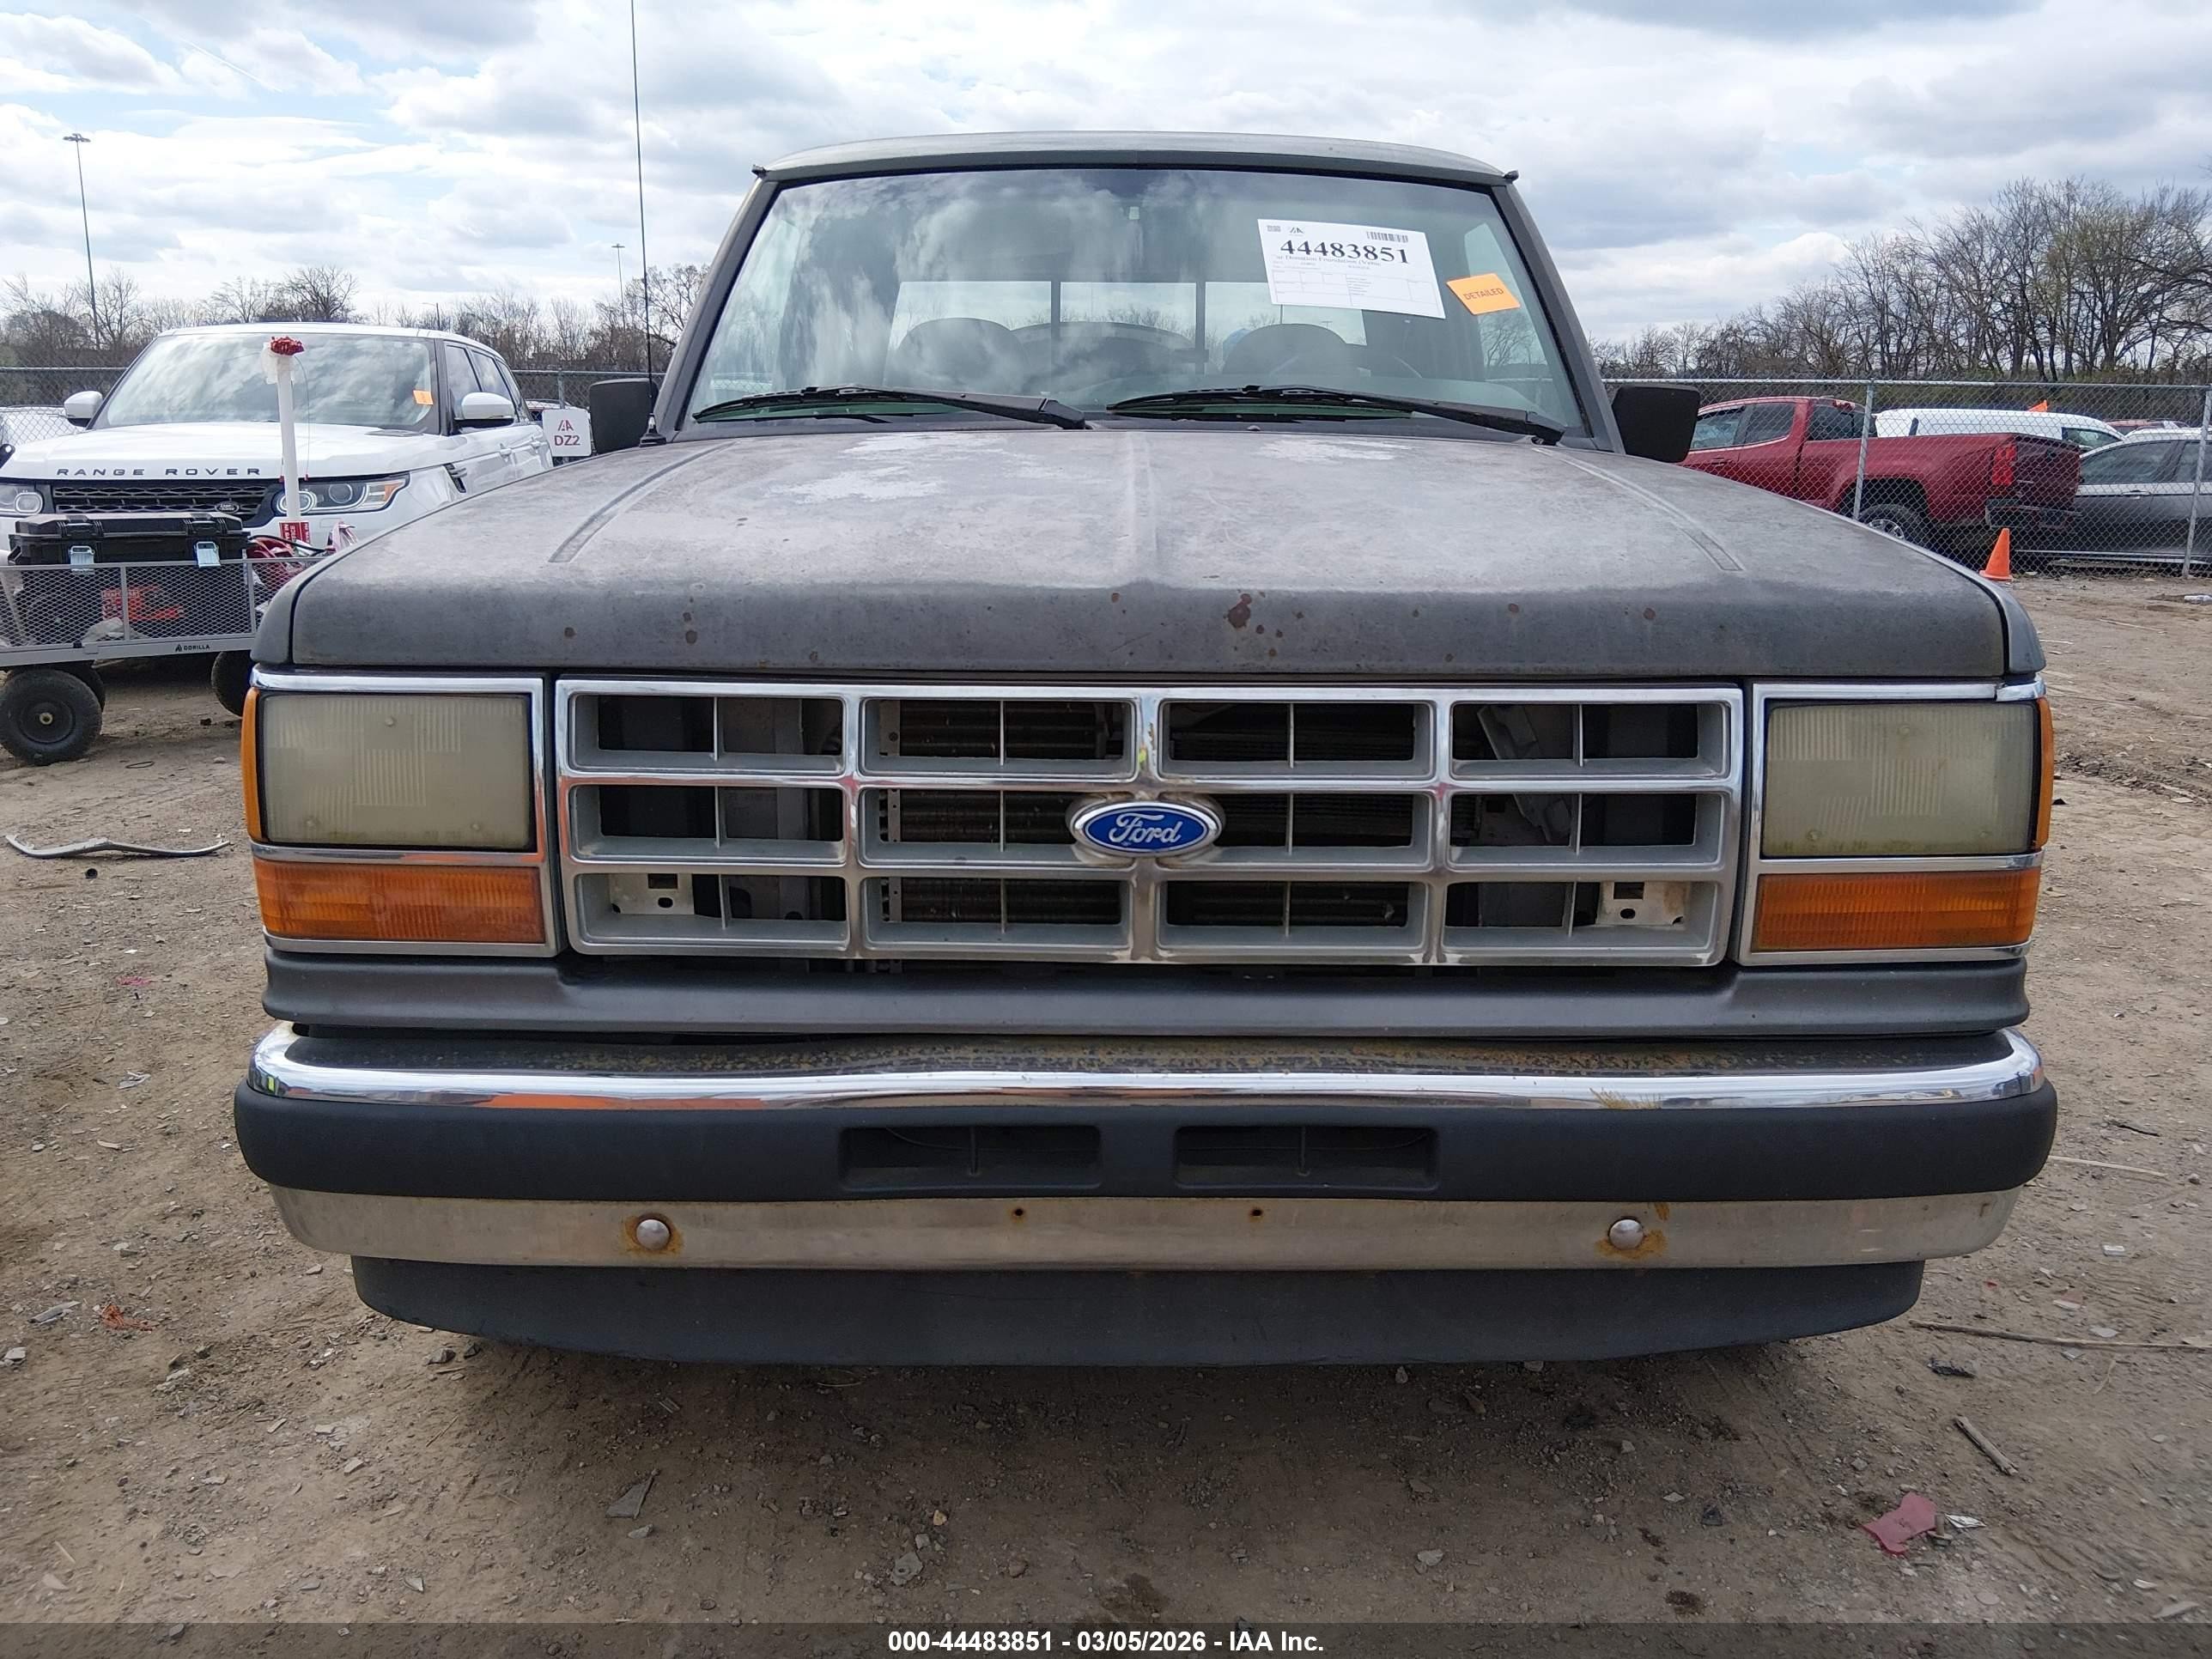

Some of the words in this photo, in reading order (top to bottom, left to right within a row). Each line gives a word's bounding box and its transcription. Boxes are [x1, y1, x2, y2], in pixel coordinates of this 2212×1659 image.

[1279, 240, 1409, 264] 44483851
[1462, 288, 1504, 301] DETAILED
[554, 434, 580, 447] DZ2
[1109, 812, 1184, 843] Ford
